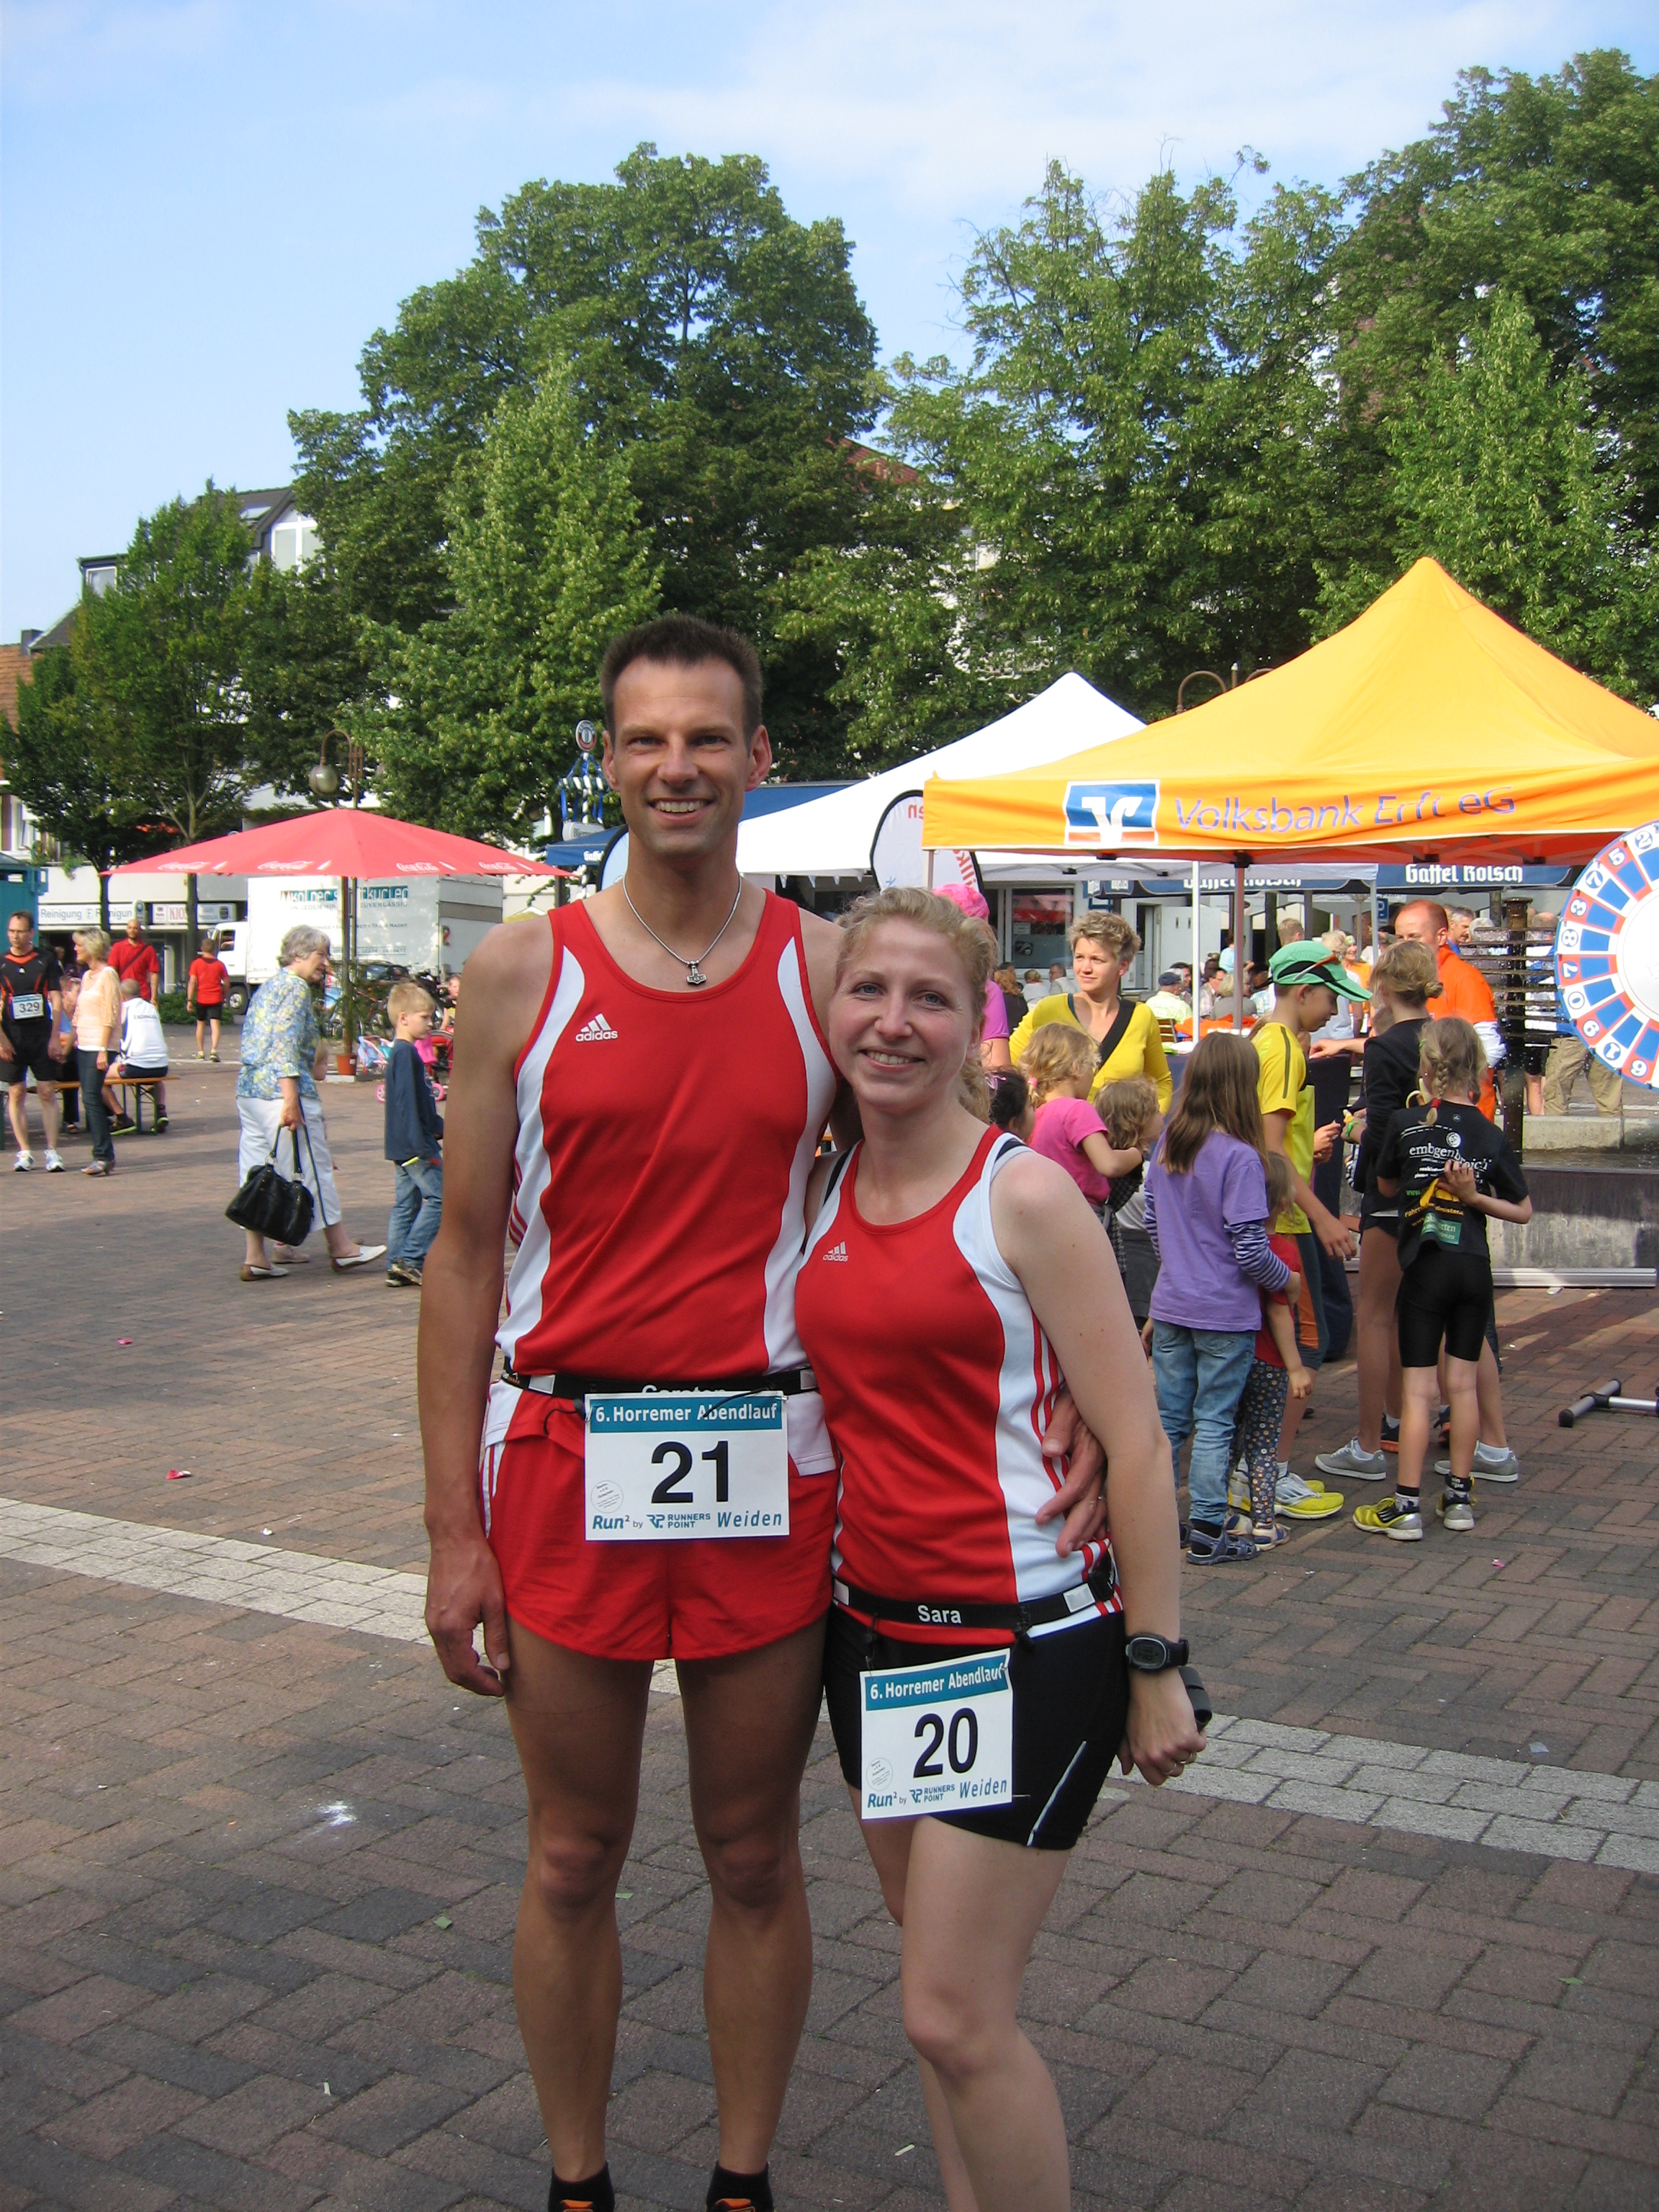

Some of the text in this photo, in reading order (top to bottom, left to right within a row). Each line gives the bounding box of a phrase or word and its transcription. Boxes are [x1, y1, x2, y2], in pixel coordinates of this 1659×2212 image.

[1174, 795, 1364, 833] Volksbank
[1458, 786, 1516, 815] eG
[1405, 863, 1460, 885] Gaffel
[40, 909, 82, 920] Reinigung
[169, 907, 188, 920] KIO
[19, 1002, 40, 1013] 329
[575, 1030, 619, 1042] adidas
[822, 1254, 849, 1262] adidas
[595, 1403, 778, 1423] 6. Horremer Abendlauf
[651, 1440, 729, 1503] 21
[632, 1520, 643, 1529] by
[717, 1510, 782, 1527] Weiden
[917, 1605, 962, 1624] Sara
[870, 1662, 1004, 1700] 6. Horremer Abendlauf
[913, 1707, 979, 1779] 20
[899, 1796, 907, 1804] by
[924, 1784, 956, 1794] RUNNERS
[959, 1777, 1007, 1799] Weiden
[924, 1793, 944, 1803] POINT
